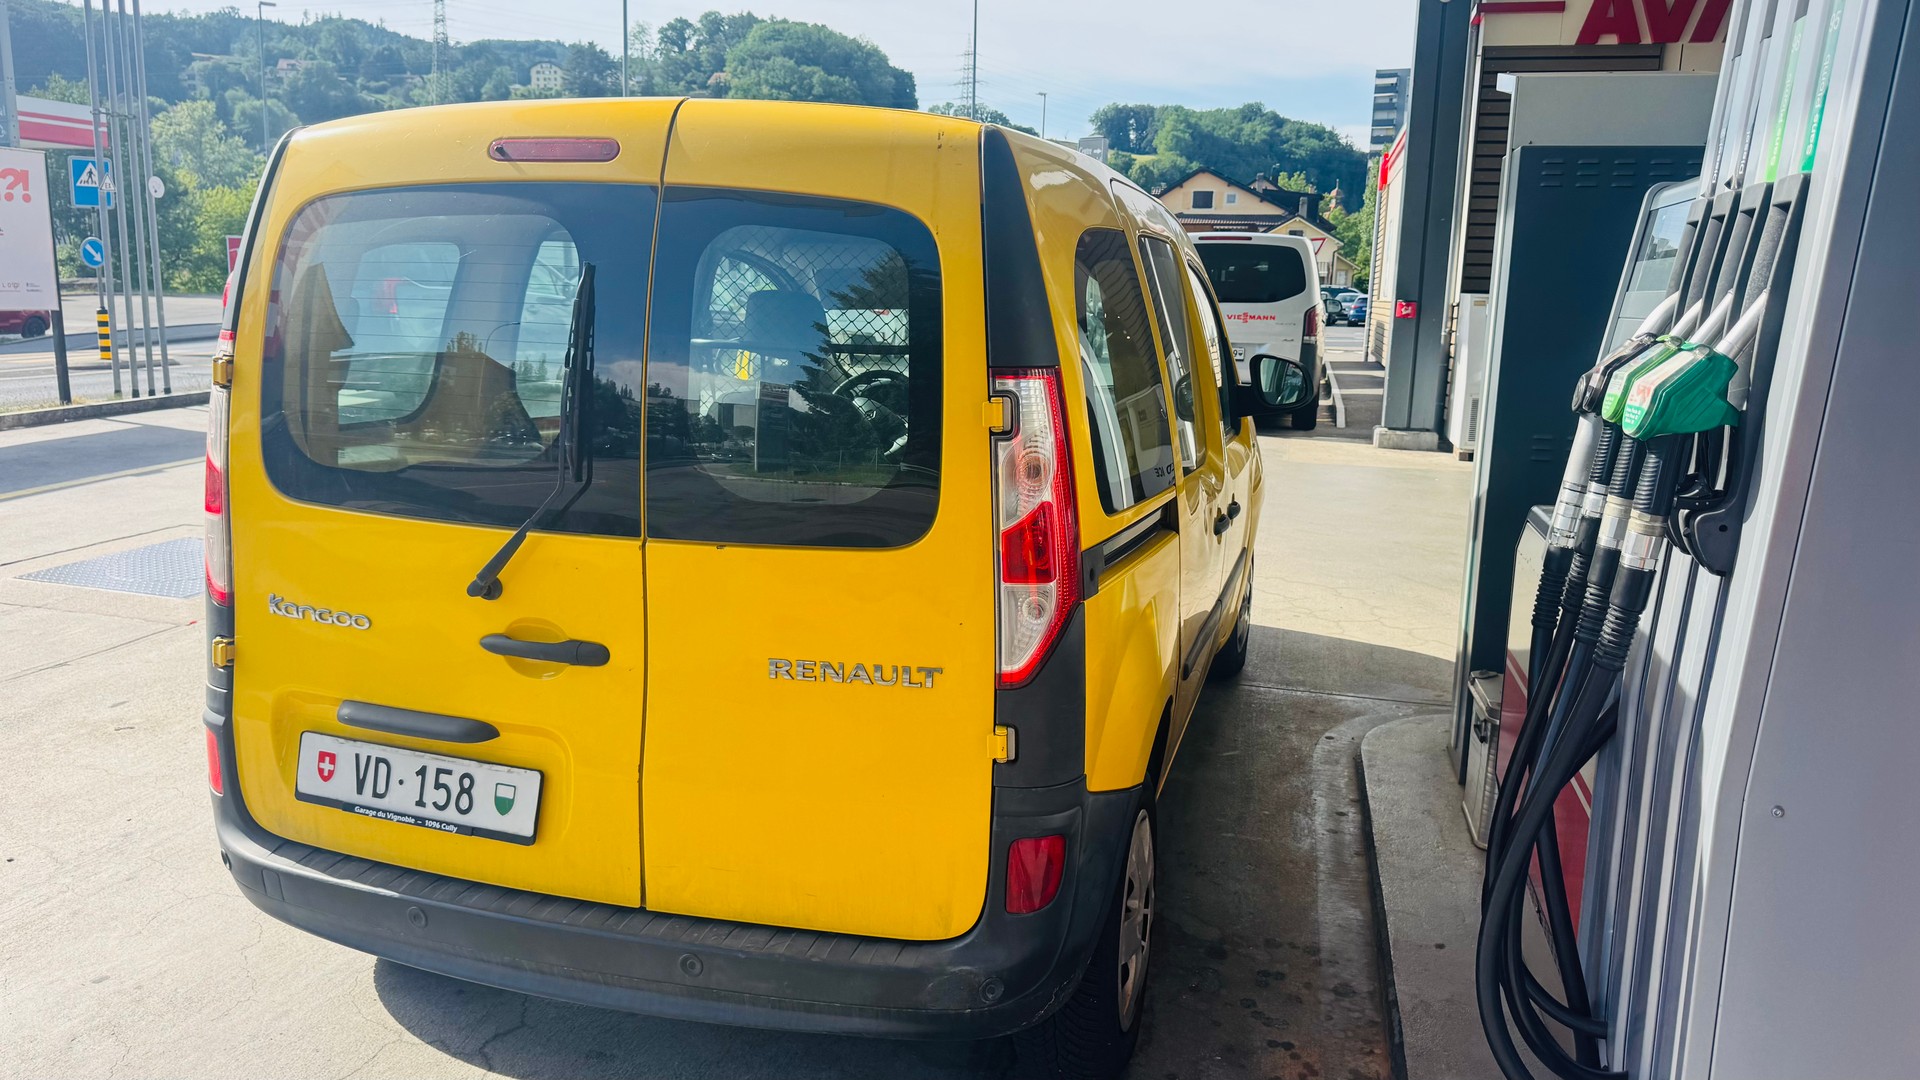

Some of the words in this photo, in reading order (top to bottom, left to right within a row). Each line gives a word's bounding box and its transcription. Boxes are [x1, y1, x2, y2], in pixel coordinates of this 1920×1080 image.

[1575, 0, 1732, 44] AVI
[1806, 113, 1820, 155] Sans
[1815, 54, 1830, 109] Plomb
[768, 658, 943, 689] RENAULT
[355, 753, 392, 799] VD
[415, 765, 475, 815] 158
[354, 806, 376, 817] Garage
[387, 812, 415, 824] Vignoble
[425, 820, 440, 829] 1096
[441, 823, 457, 833] Cully
